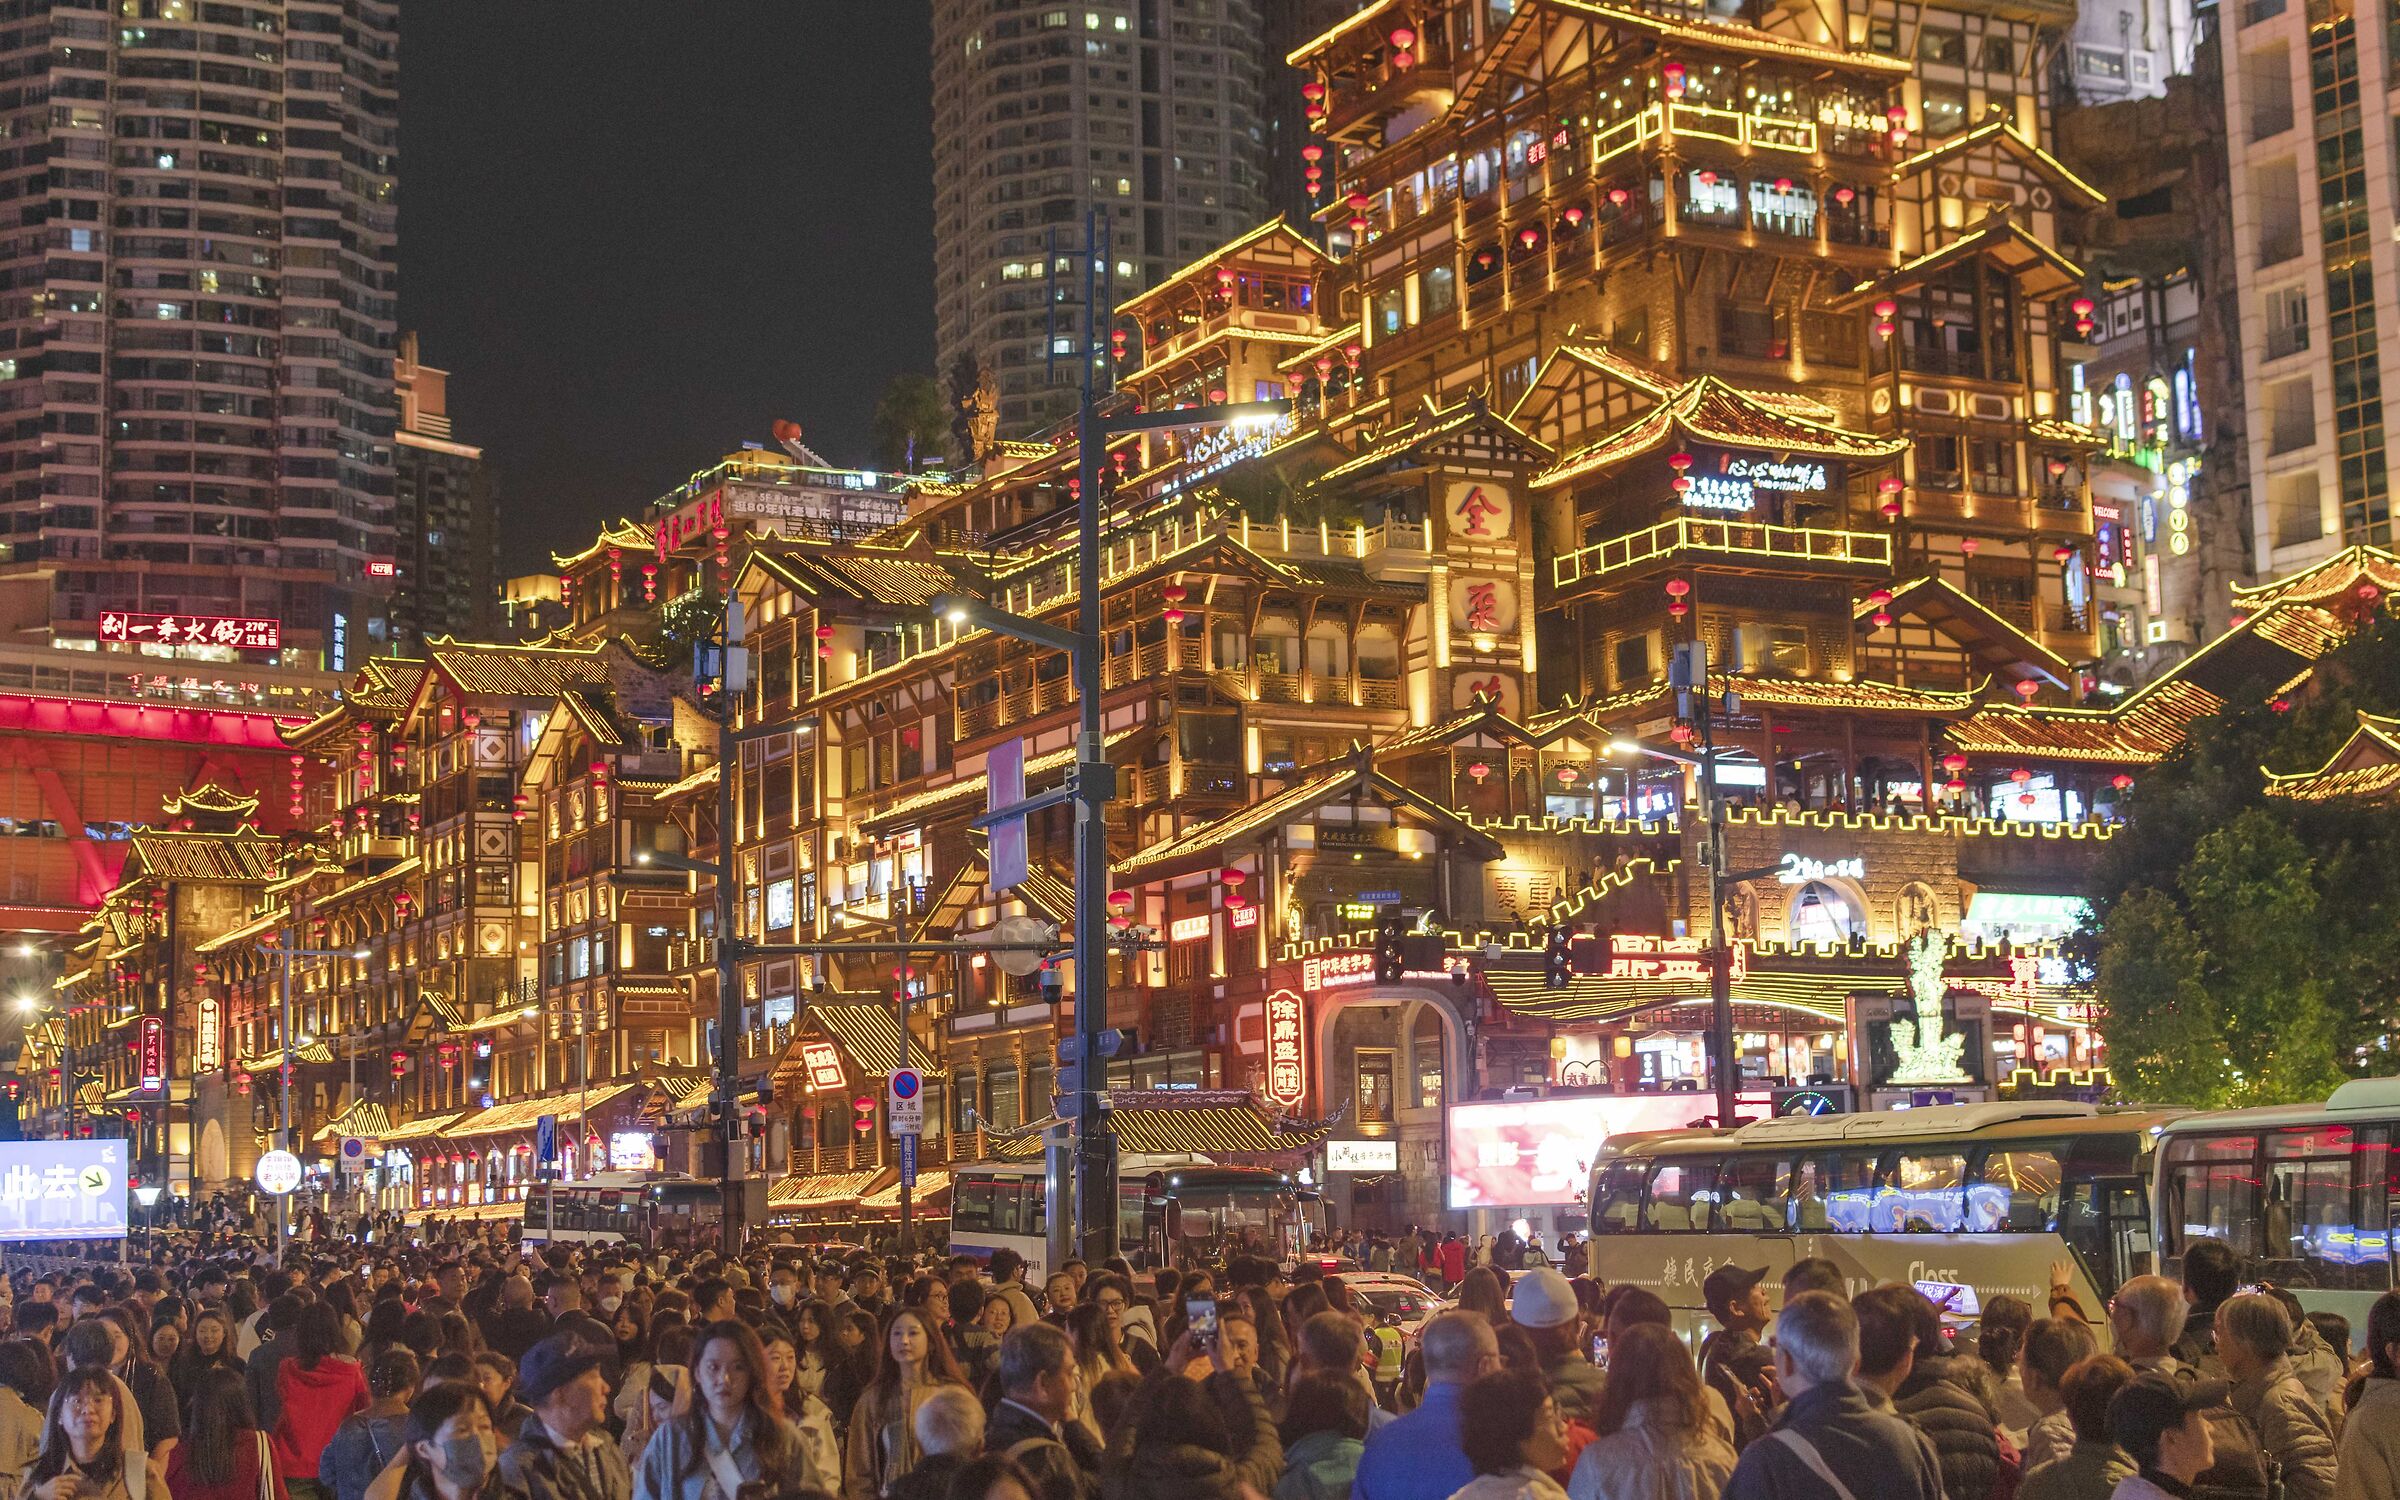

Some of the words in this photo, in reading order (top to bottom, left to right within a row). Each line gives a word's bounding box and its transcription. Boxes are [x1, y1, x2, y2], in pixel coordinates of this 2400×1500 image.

[246, 622, 268, 632] 270°
[246, 634, 267, 646] 江景
[1271, 1000, 1299, 1060] 徐鼎盛
[896, 1102, 916, 1110] 区域
[904, 1136, 913, 1186] 嘉陵江滨江路
